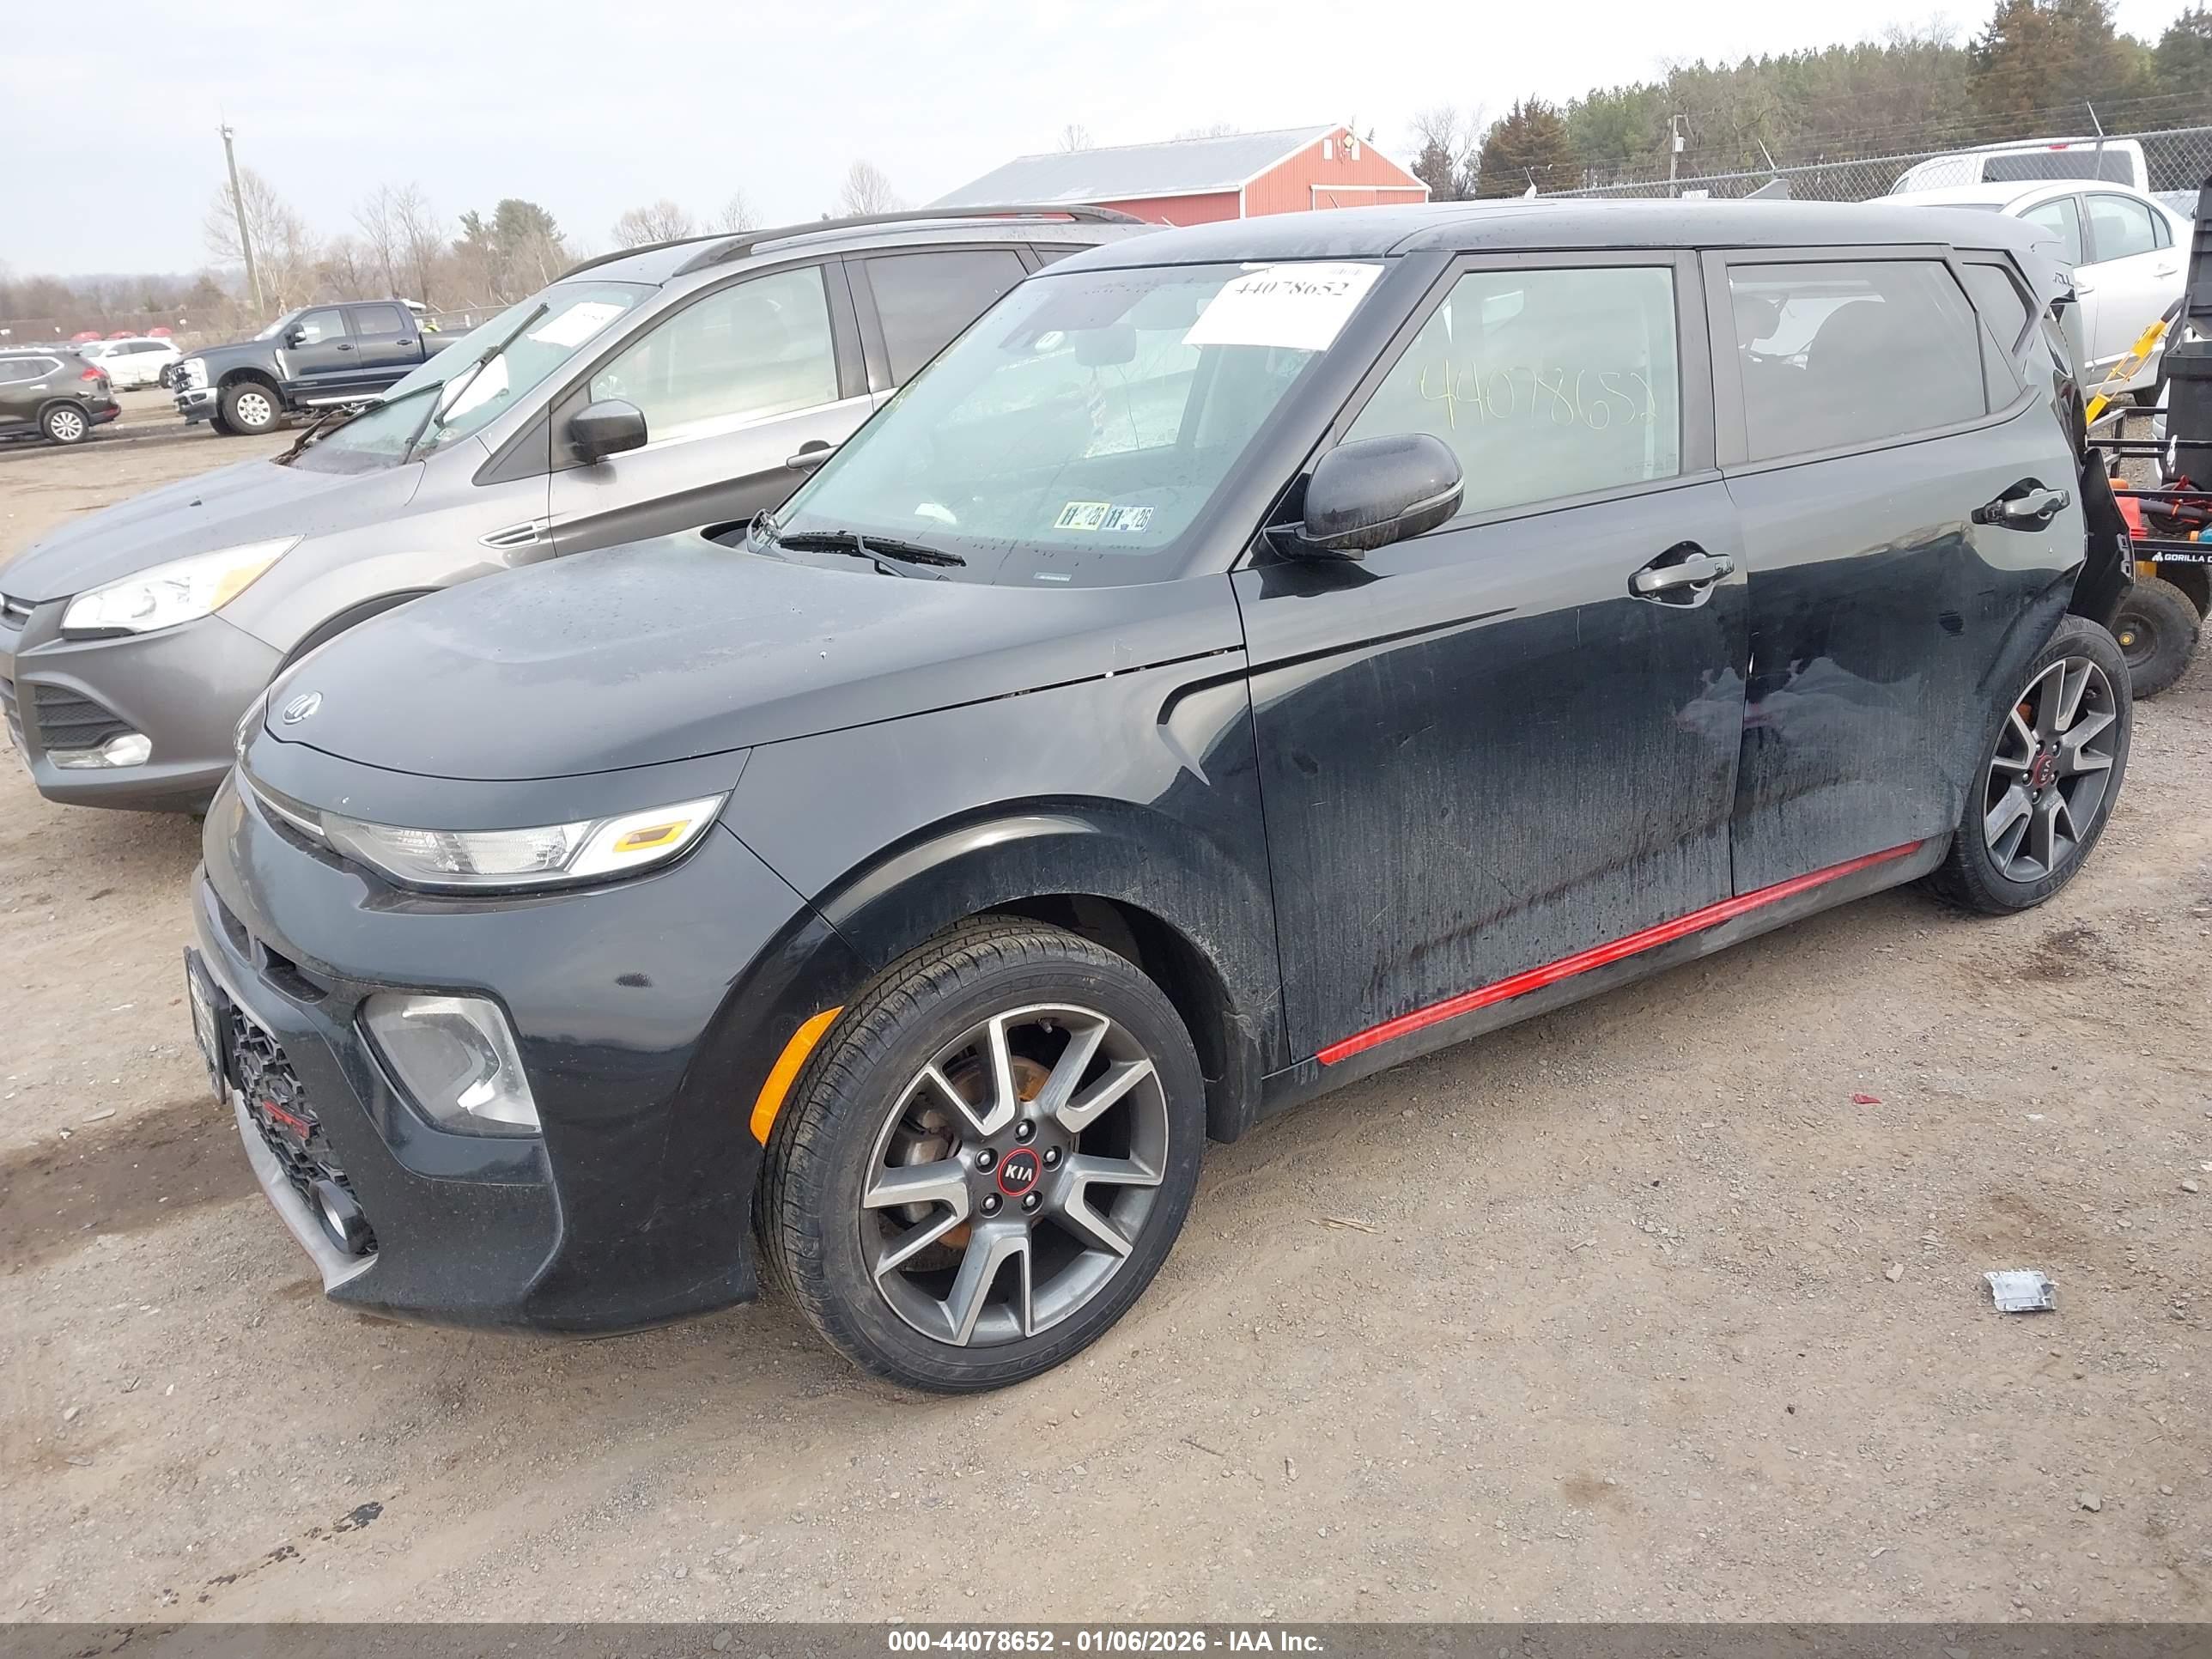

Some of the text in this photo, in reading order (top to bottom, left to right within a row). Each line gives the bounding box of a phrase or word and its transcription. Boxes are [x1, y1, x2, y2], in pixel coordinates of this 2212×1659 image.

[1236, 281, 1351, 296] 44078652
[2164, 553, 2205, 563] GORILLA
[1004, 1164, 1033, 1182] KIA
